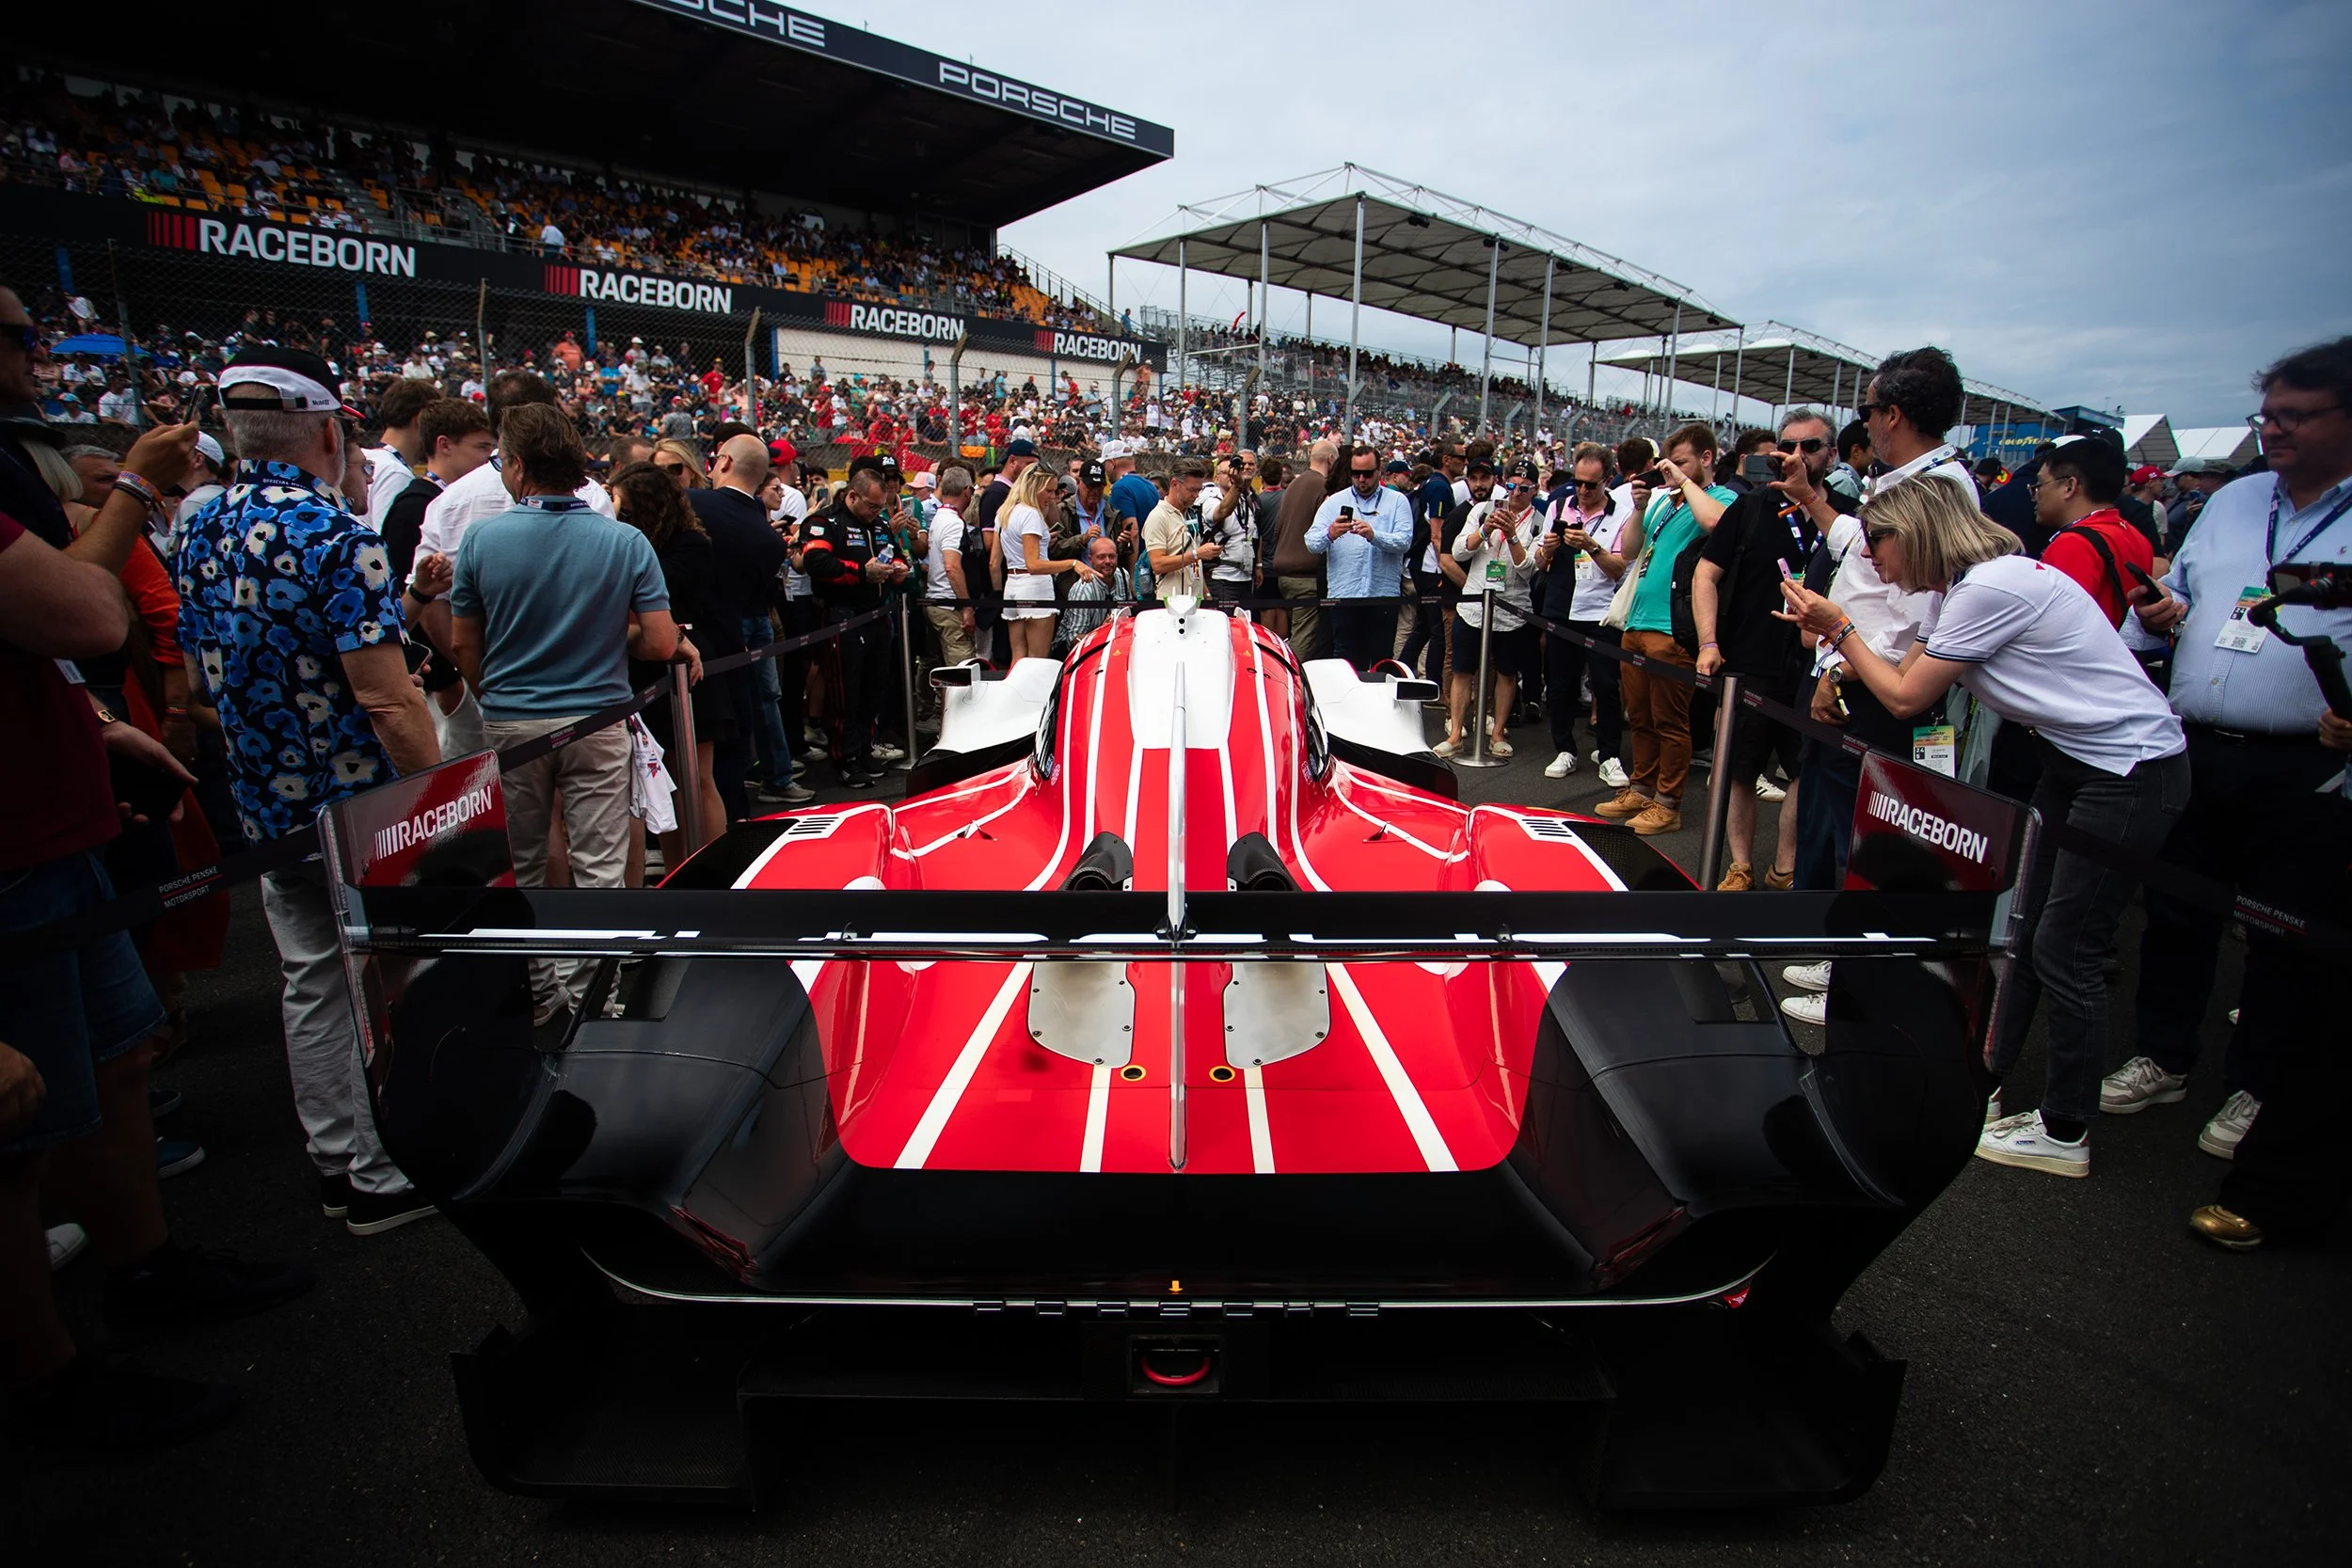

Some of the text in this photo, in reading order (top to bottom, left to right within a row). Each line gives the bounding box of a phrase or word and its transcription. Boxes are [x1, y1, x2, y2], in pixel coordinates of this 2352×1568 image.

[939, 61, 1136, 140] PORSCHE
[199, 217, 416, 278] RACEBORN
[580, 269, 733, 315] RACEBORN
[849, 304, 965, 341] RACEBORN
[1053, 332, 1142, 364] RACEBORN
[262, 478, 291, 486] OFFICIAL
[397, 784, 493, 850] RACEBORN
[1884, 798, 1989, 864] RACEBORN
[158, 864, 218, 894] PORSCHE PENSKE
[163, 884, 211, 909] MOTORSPORT
[2232, 910, 2286, 938] MOTORSPORT
[2235, 895, 2307, 928] PORSCHE PENSKE
